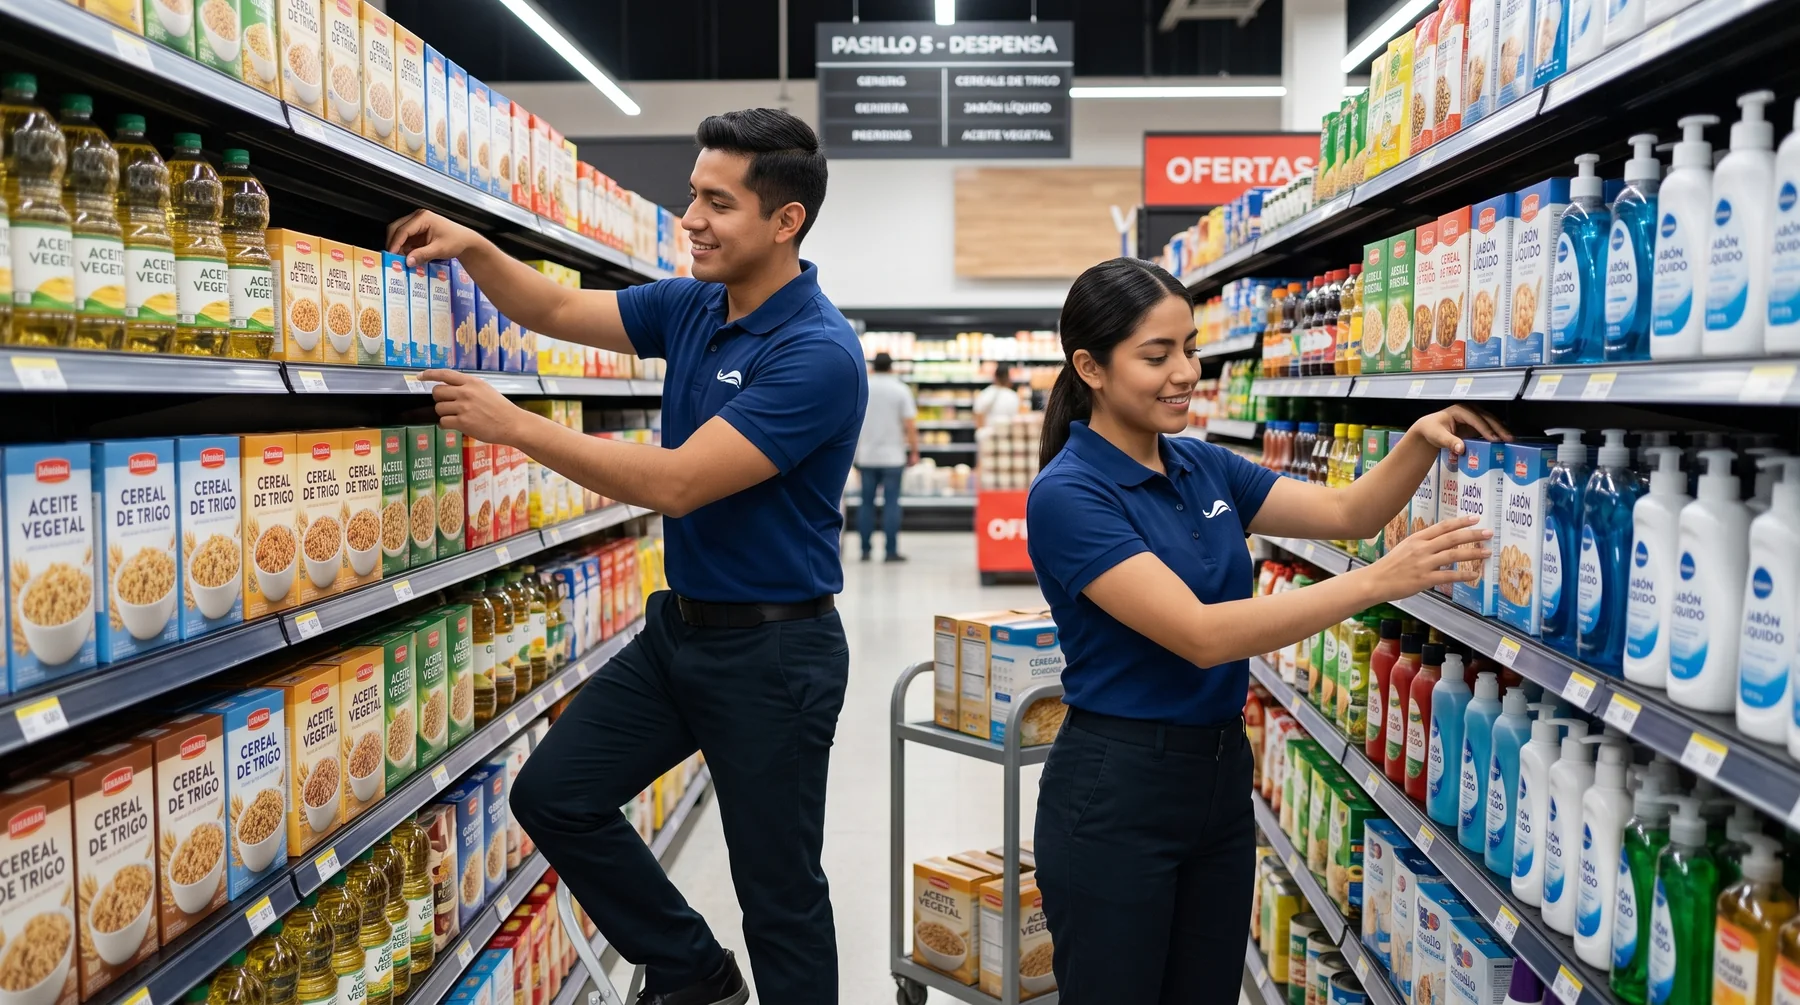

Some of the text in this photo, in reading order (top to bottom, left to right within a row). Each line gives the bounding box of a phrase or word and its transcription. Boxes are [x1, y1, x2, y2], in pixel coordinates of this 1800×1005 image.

[832, 35, 917, 54] PASILLO
[920, 36, 934, 54] 5
[949, 35, 1058, 54] DESPENSA
[1166, 156, 1313, 184] OFERTAS
[37, 237, 71, 252] ACEIT
[1659, 246, 1683, 260] ABÓN
[80, 261, 124, 276] VEGETA
[200, 268, 228, 281] ACEIT
[290, 271, 298, 282] DE
[250, 276, 272, 287] ACEIT
[327, 278, 335, 289] DE
[306, 469, 337, 484] CEREAL
[348, 464, 376, 479] CEREAL
[194, 478, 233, 496] CEREAL
[257, 474, 291, 490] CEREAL
[345, 478, 379, 494] DE TRIGO
[1462, 483, 1481, 499] JABÓN
[121, 485, 166, 506] CEREAL
[254, 490, 294, 508] DE TRIGO
[303, 484, 340, 501] DE TRIGO
[1509, 492, 1530, 510] JABÓN
[28, 494, 78, 517] ACEITE
[190, 496, 237, 516] DE TRIGO
[117, 504, 171, 527] DE TRIGO
[22, 516, 85, 540] VEGETAL
[352, 684, 378, 706] ACEITE
[307, 706, 333, 731] ACEITE
[349, 697, 381, 722] VEGETAL
[303, 721, 337, 748] VEGETAL
[240, 732, 277, 759] CEREAL
[237, 747, 281, 780] DE TRIGO
[172, 760, 215, 792] CEREAL
[168, 776, 219, 815] DE TRIGO
[94, 795, 142, 832] CEREAL
[89, 813, 148, 857] DE TRIGO
[0, 837, 58, 879] CEREAL
[20, 856, 65, 894] TRIGO
[918, 896, 962, 920] VEGETAL
[923, 889, 956, 908] ACEITE
[1027, 912, 1047, 924] ACE
